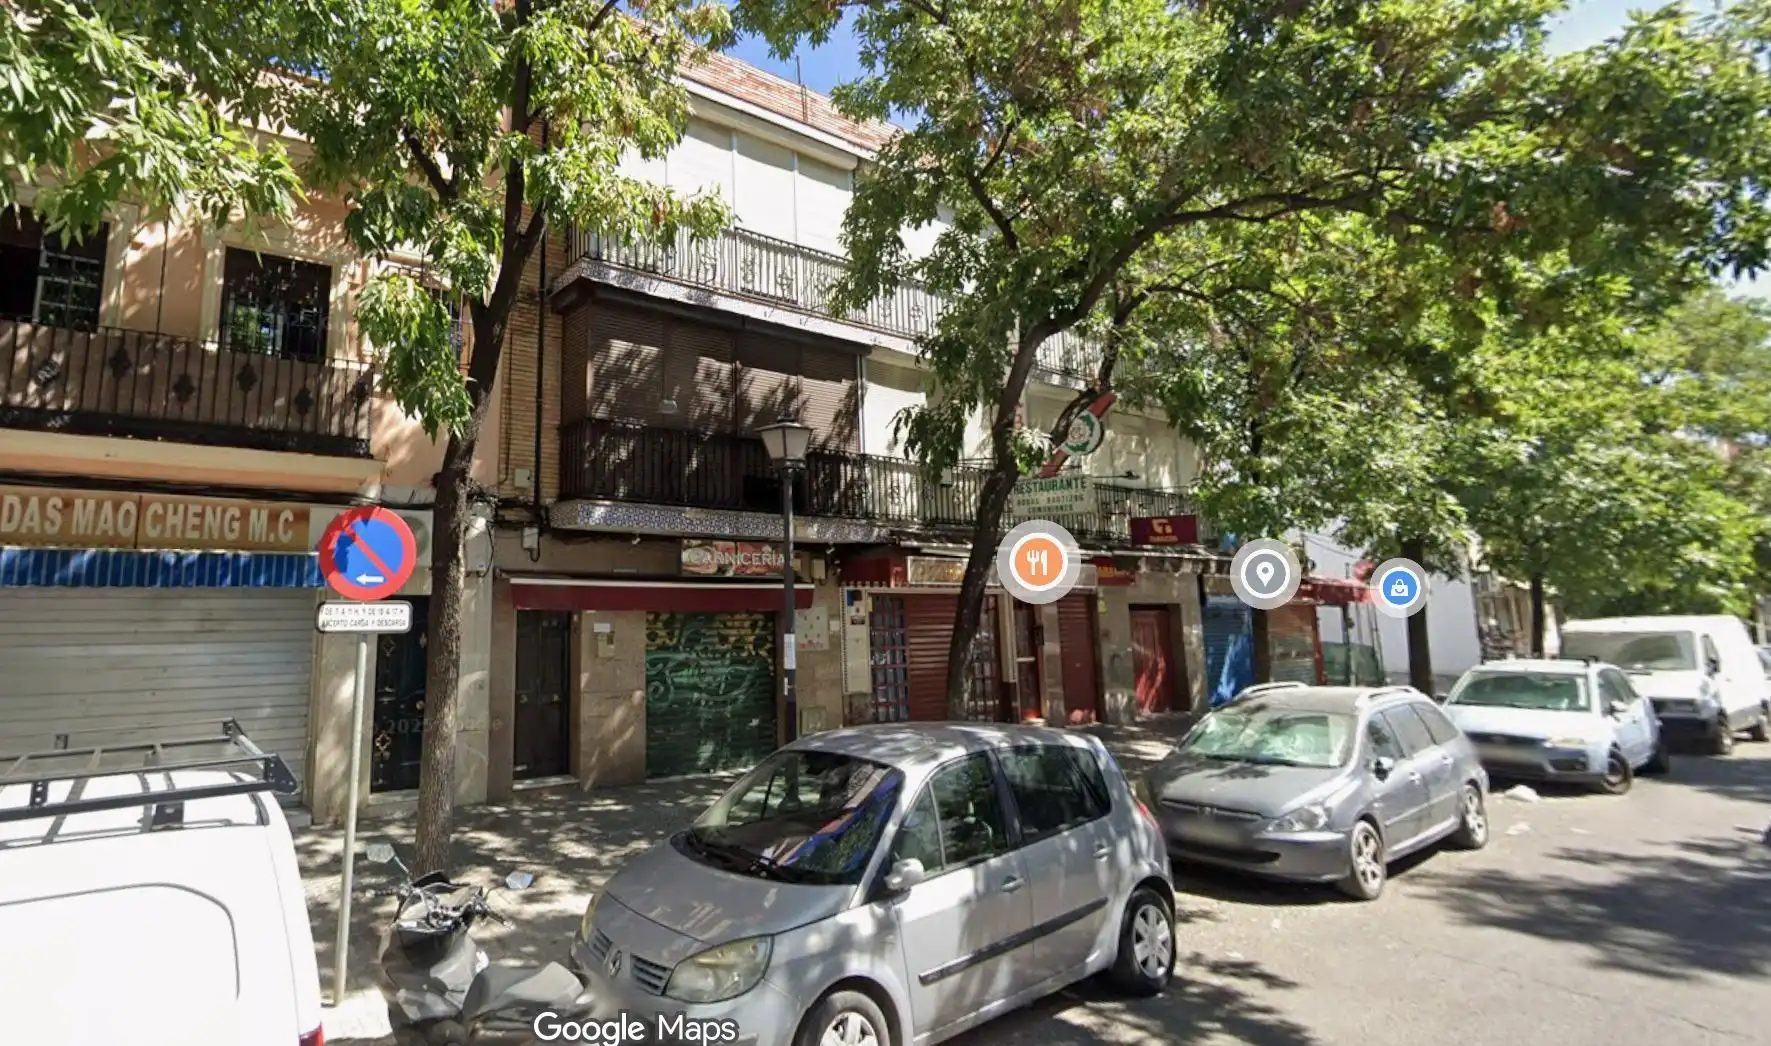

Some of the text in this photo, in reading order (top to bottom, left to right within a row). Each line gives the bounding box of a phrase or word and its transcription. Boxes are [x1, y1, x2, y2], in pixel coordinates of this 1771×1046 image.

[1014, 477, 1086, 494] RESTAURANTE
[1, 494, 294, 543] DAS MAO CHENG M.C
